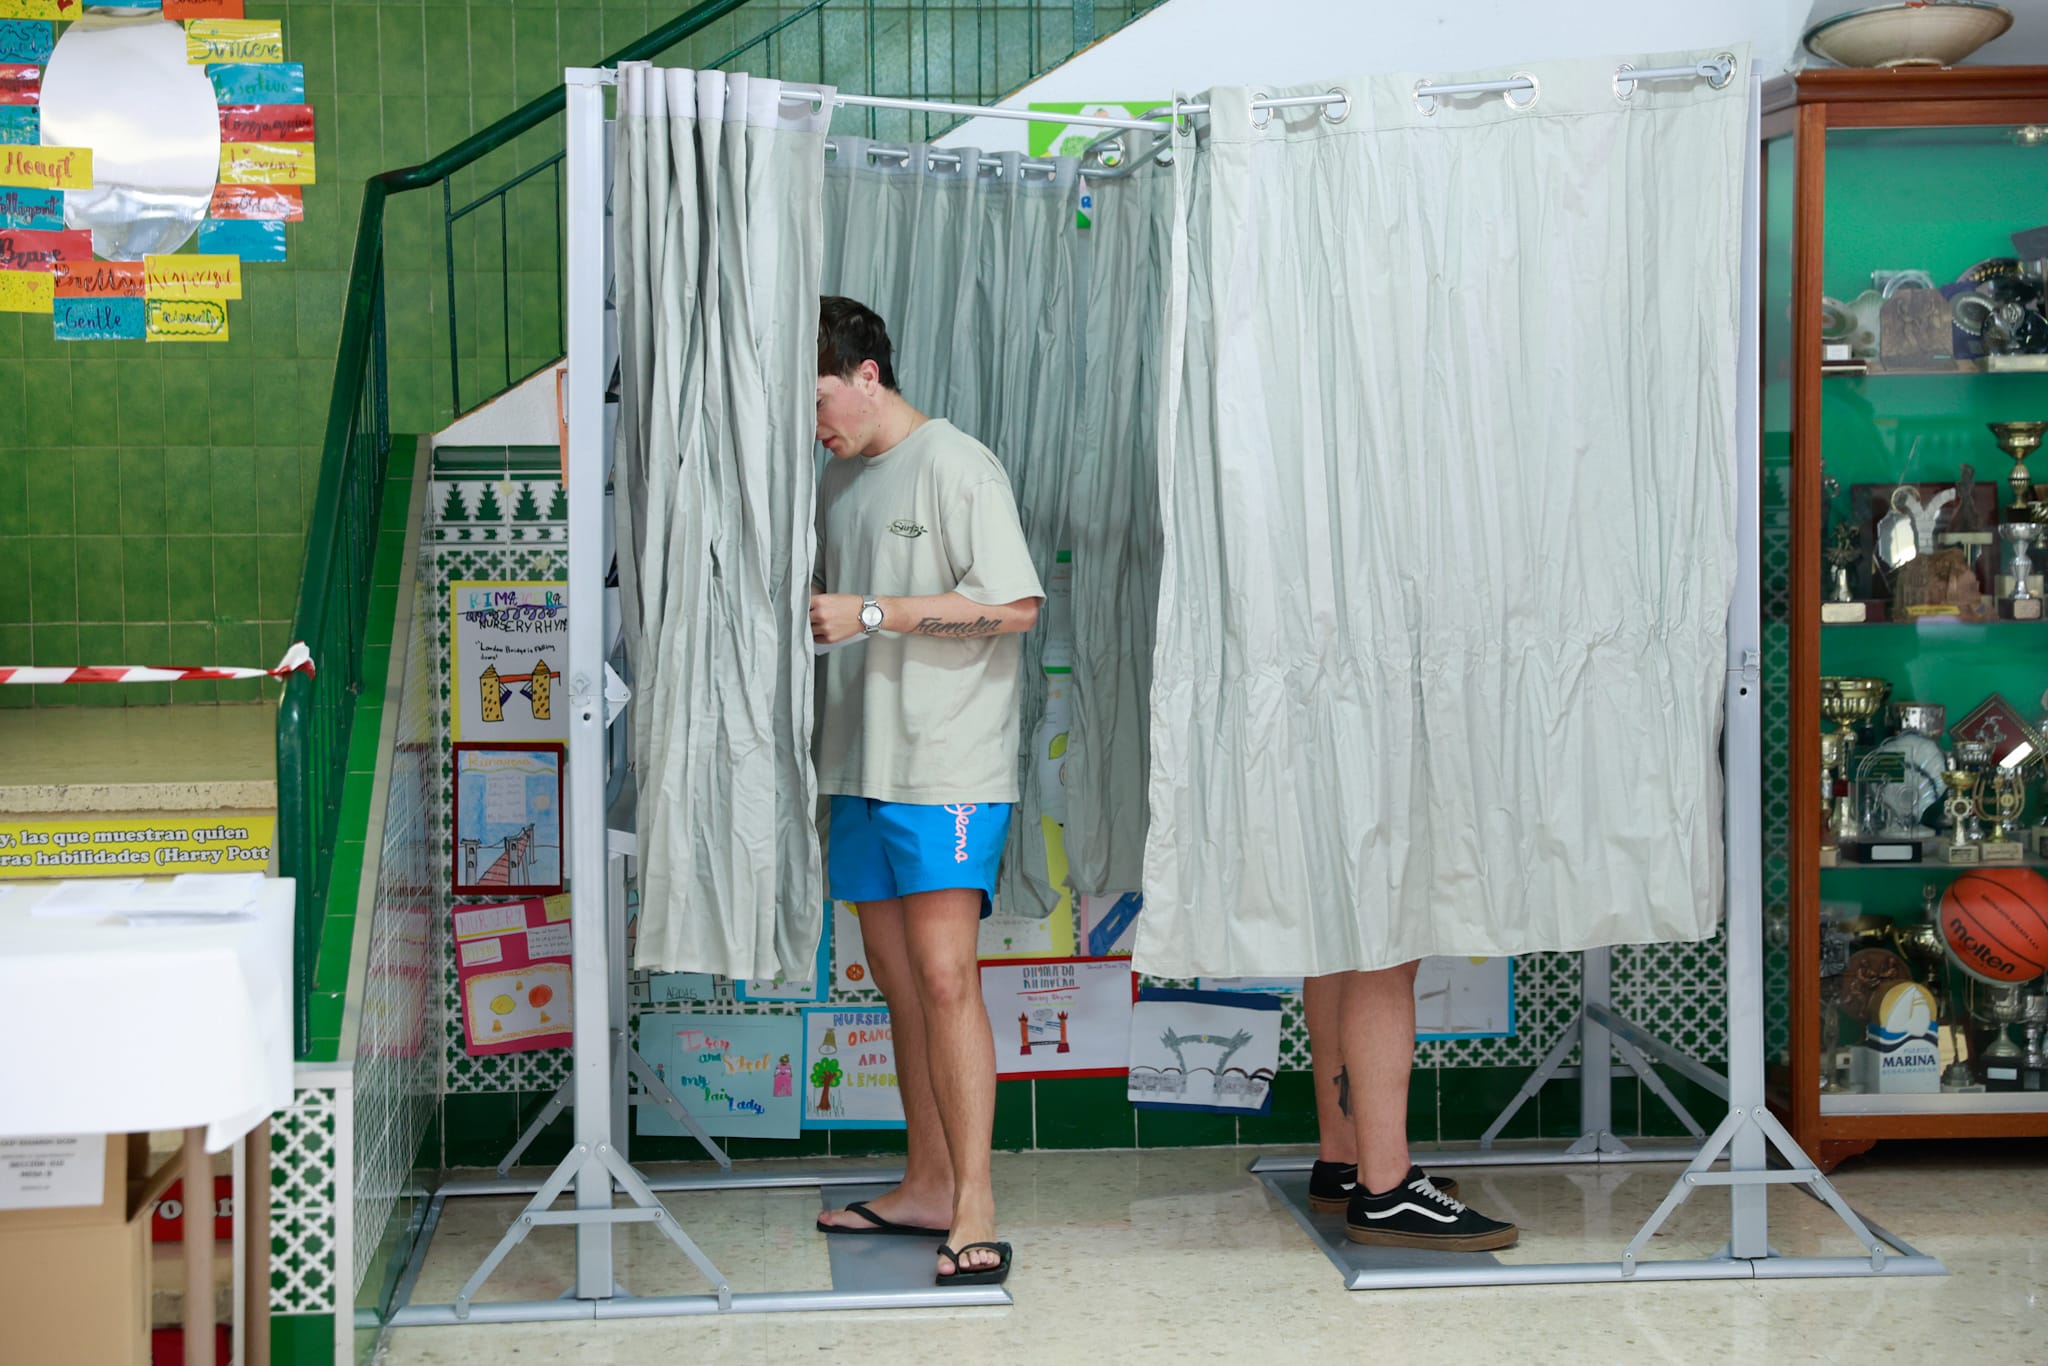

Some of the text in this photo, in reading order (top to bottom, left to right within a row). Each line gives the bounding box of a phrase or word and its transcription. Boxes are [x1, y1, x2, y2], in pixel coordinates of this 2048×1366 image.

[65, 306, 121, 330] Gentle
[21, 830, 49, 845] las
[53, 831, 90, 848] que
[93, 827, 190, 844] muestran
[192, 826, 249, 843] quien
[36, 849, 150, 866] habilidades
[154, 847, 223, 866] (Harry
[1950, 917, 2016, 975] molten
[858, 1053, 888, 1067] AND
[1882, 1054, 1937, 1068] MARINA
[728, 1097, 765, 1115] Lady
